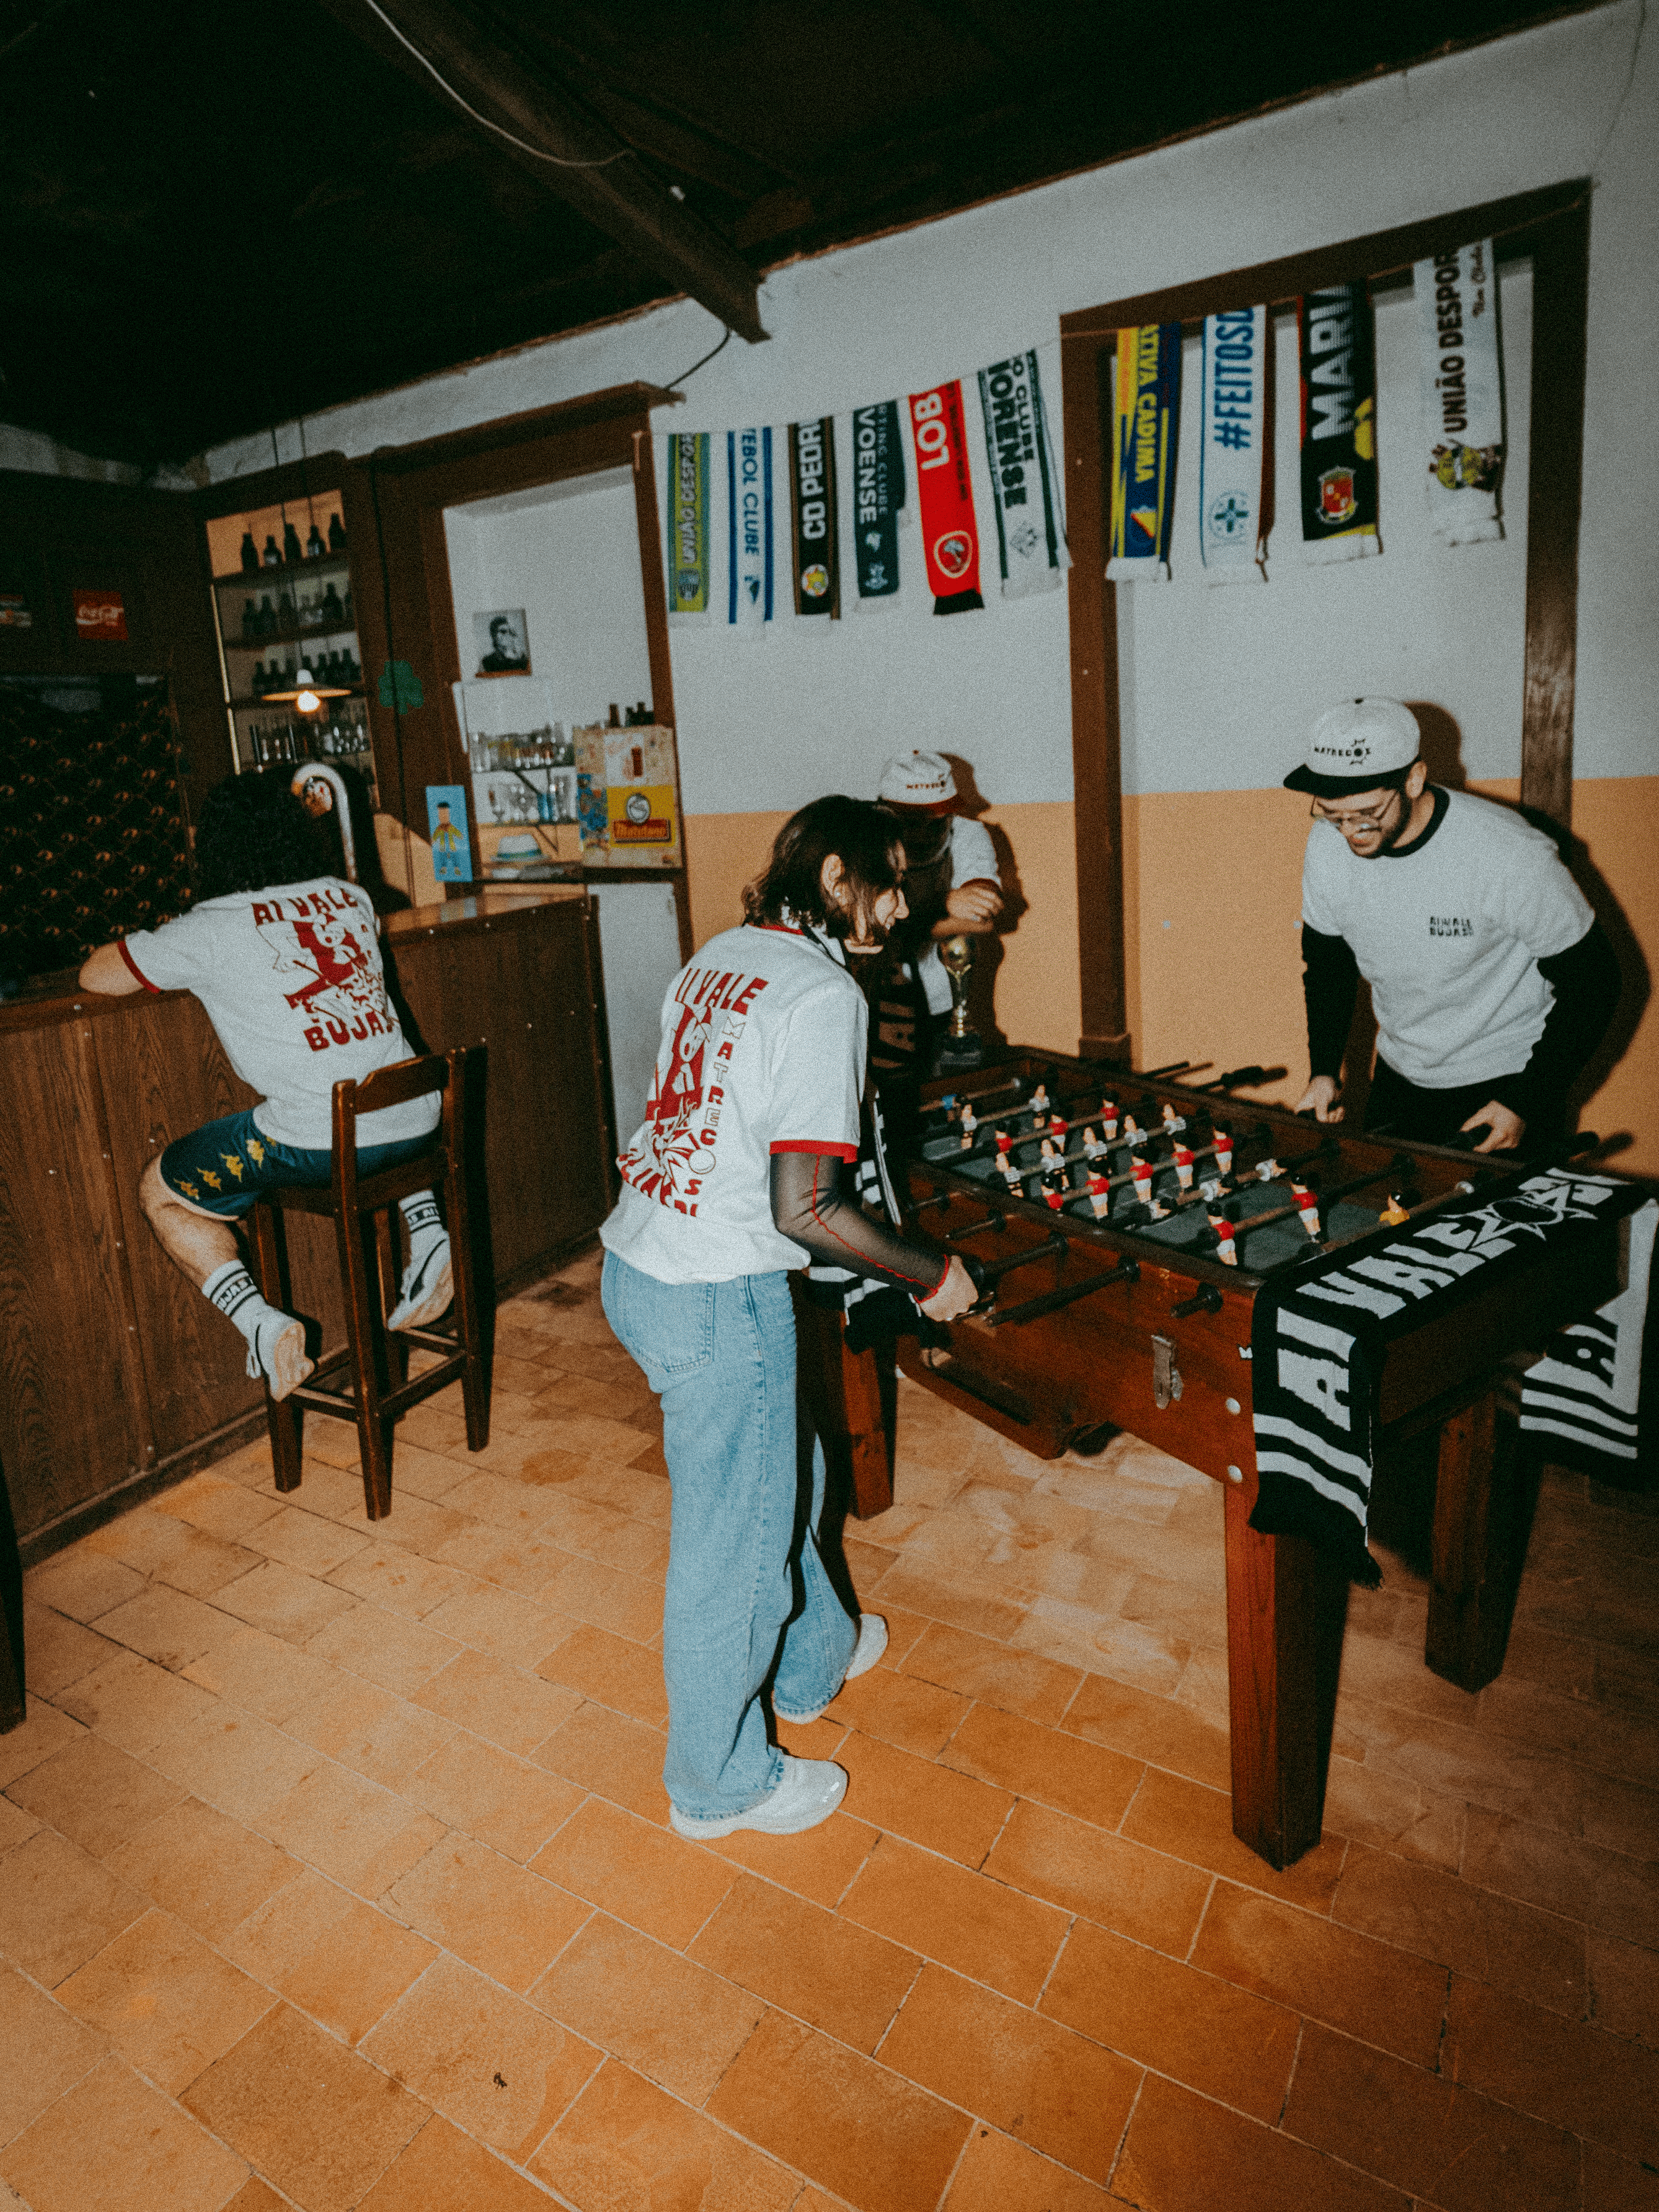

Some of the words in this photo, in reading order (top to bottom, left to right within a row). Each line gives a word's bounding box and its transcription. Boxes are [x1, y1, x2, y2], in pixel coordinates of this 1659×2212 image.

[914, 392, 950, 471] LOB
[1015, 384, 1035, 461] CLUBE
[1435, 355, 1468, 433] UNIÃO
[857, 408, 878, 524] VOENSE
[1135, 392, 1157, 483] CADIMA
[743, 492, 759, 556] CLUBE
[802, 501, 826, 540] CD
[303, 1010, 385, 1051] BUJA
